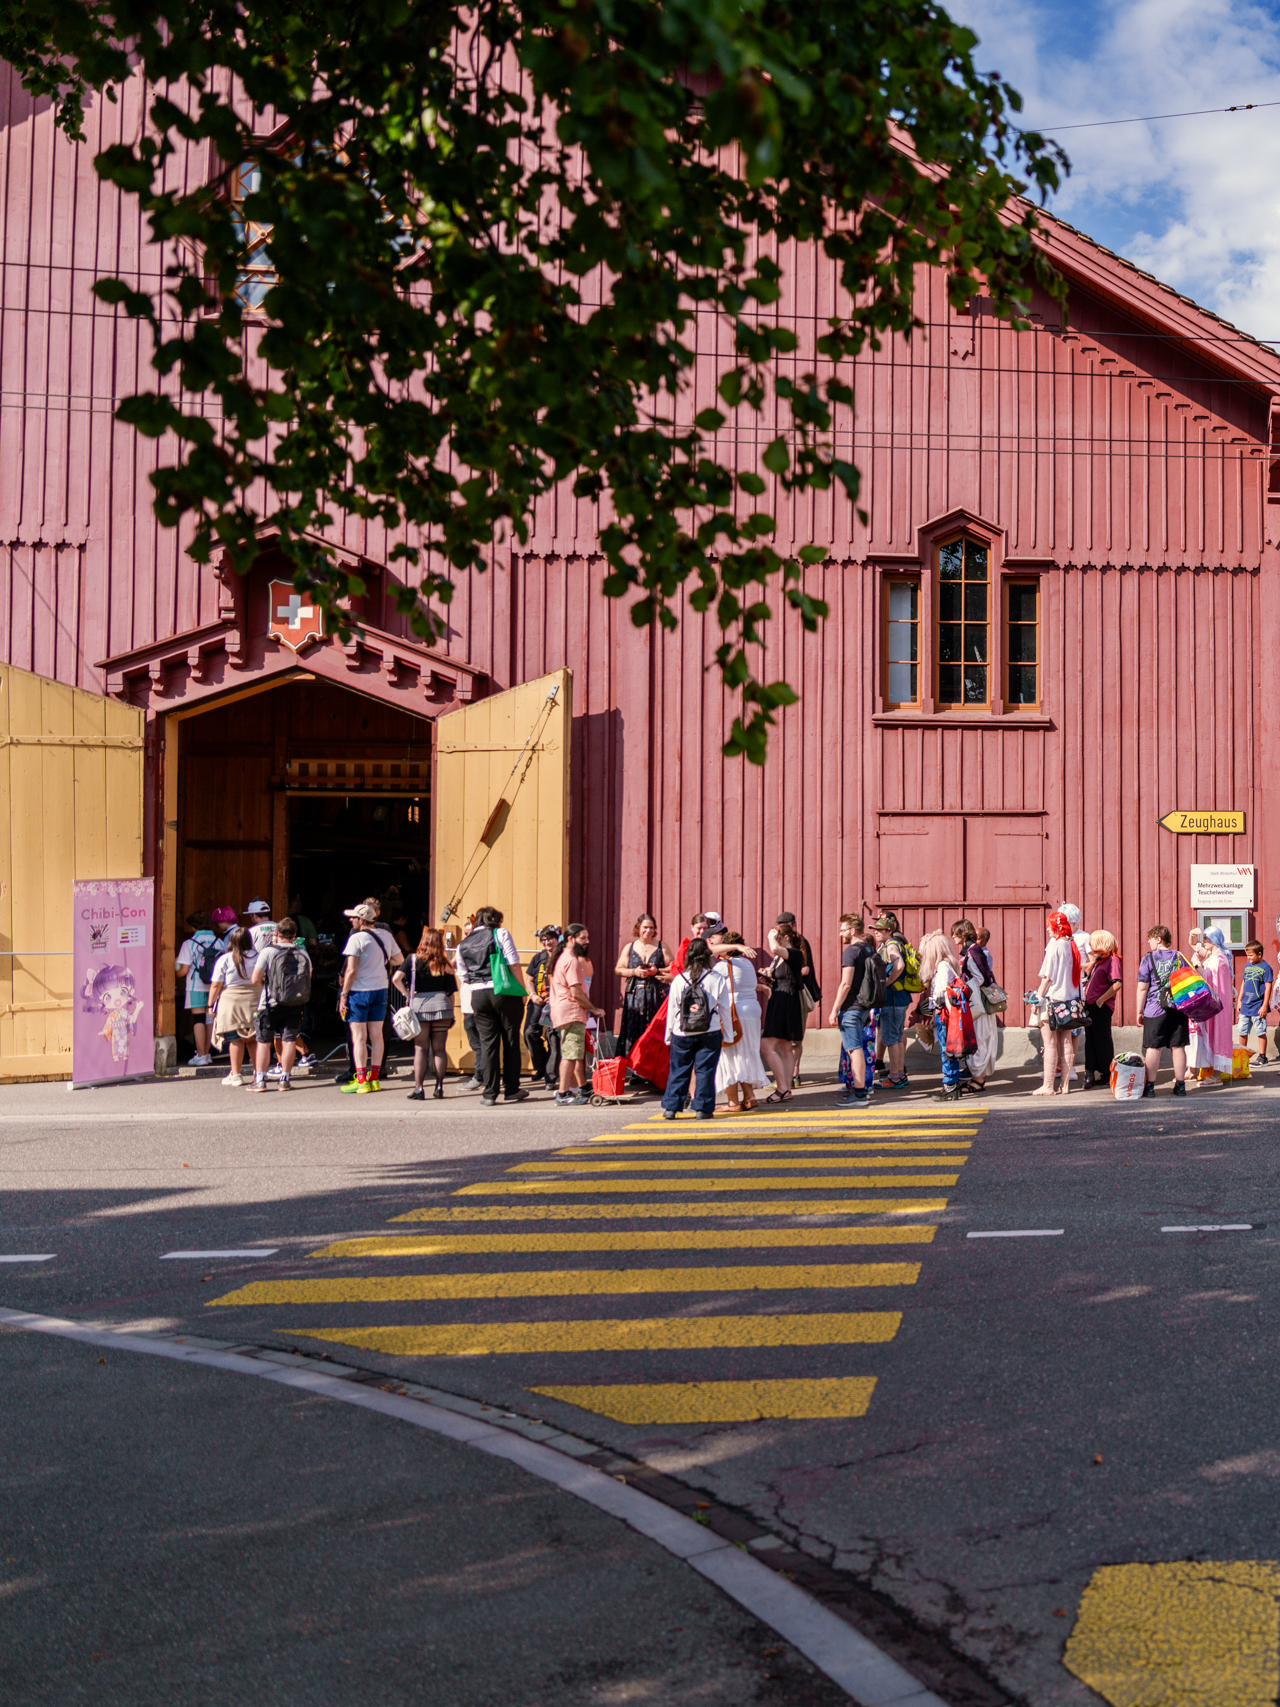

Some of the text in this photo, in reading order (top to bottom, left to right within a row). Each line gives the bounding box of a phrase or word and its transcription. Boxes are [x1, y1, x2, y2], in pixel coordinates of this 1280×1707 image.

[1180, 815, 1238, 831] Zeughaus
[81, 907, 146, 920] Chibi-Con
[1127, 1073, 1136, 1098] MIGROS
